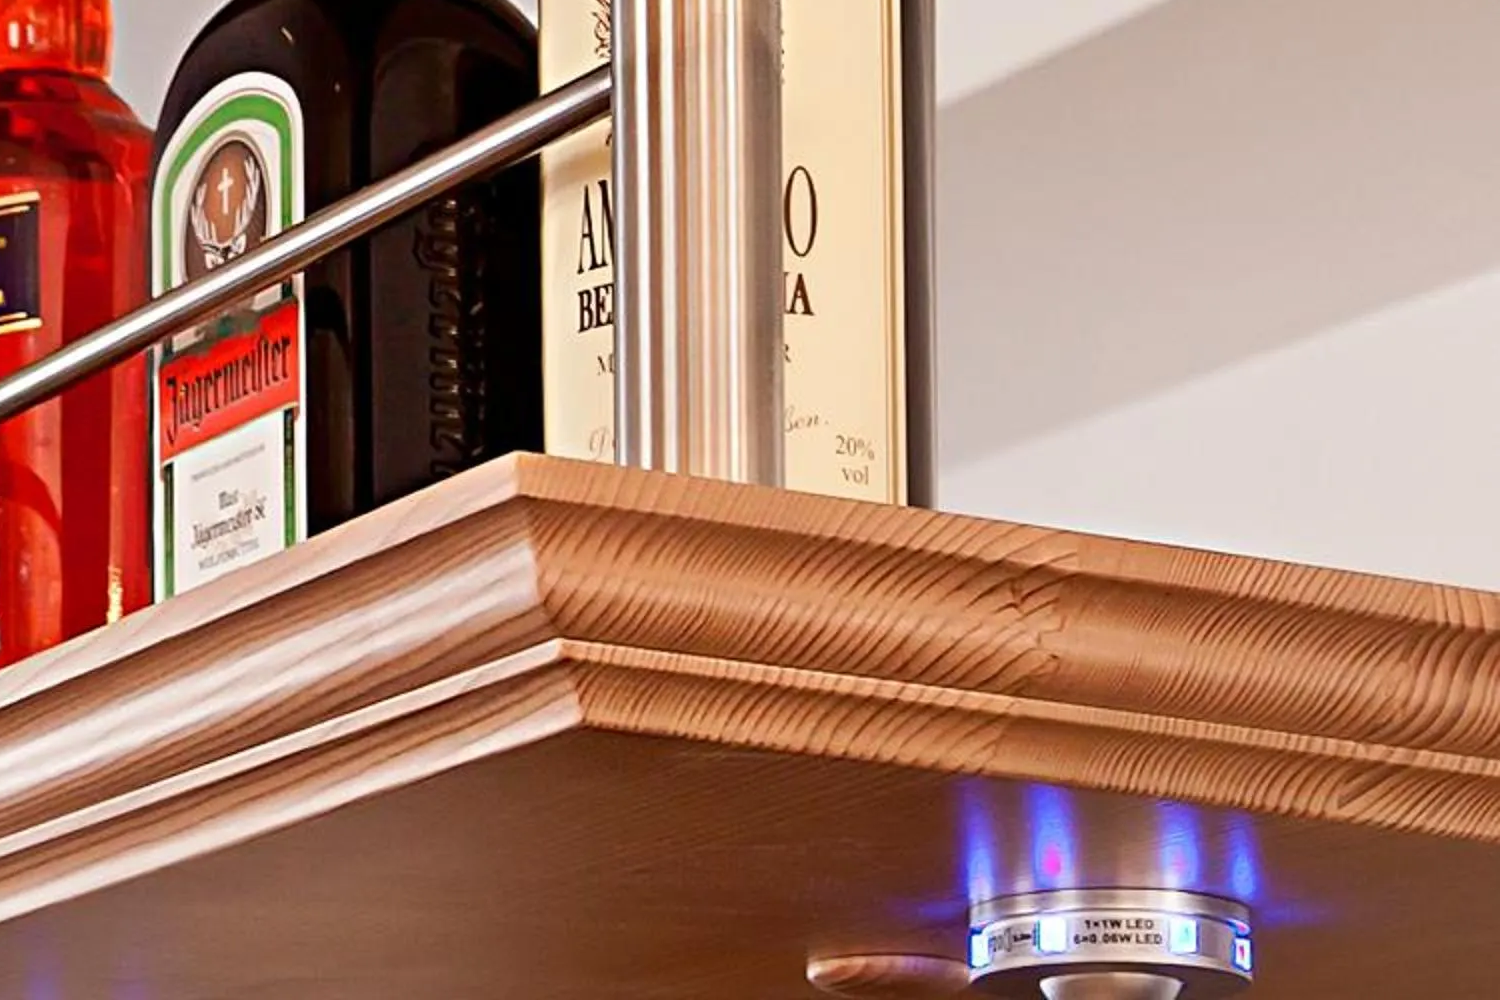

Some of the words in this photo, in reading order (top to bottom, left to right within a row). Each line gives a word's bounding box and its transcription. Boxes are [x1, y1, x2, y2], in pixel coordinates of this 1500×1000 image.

[835, 434, 875, 461] 20%
[841, 465, 870, 486] vol
[1125, 918, 1155, 930] LED
[1135, 933, 1163, 945] LED
